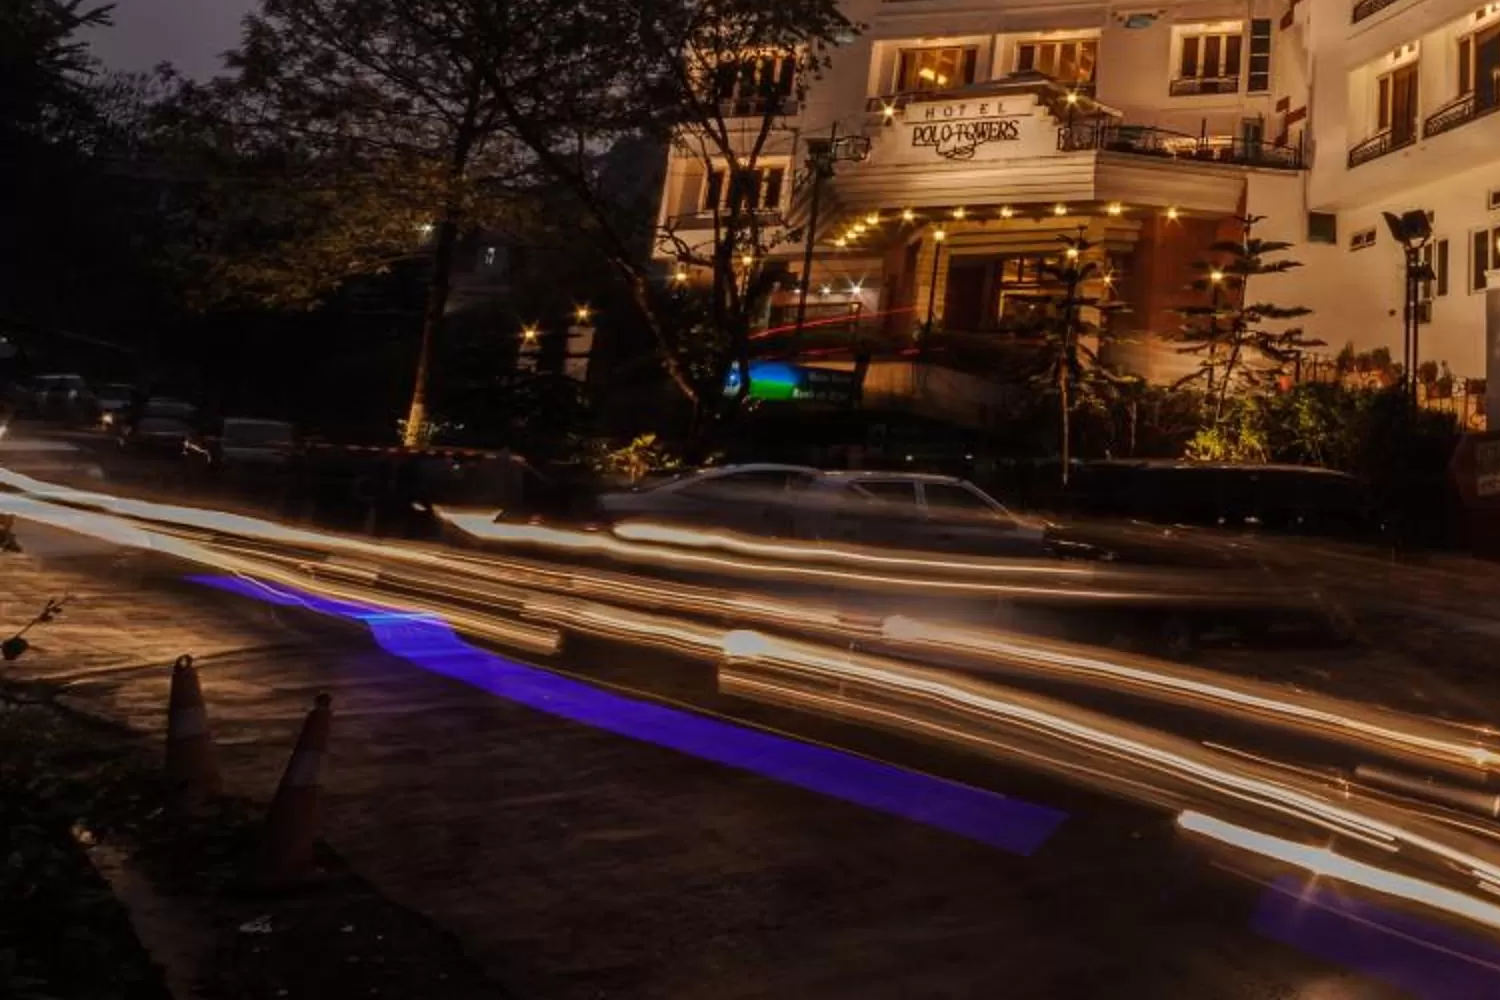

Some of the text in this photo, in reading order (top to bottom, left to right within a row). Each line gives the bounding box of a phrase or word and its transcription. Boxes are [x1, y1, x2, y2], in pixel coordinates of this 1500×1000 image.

[926, 101, 1006, 119] HOTEL
[912, 120, 1020, 145] POLO TOWERS
